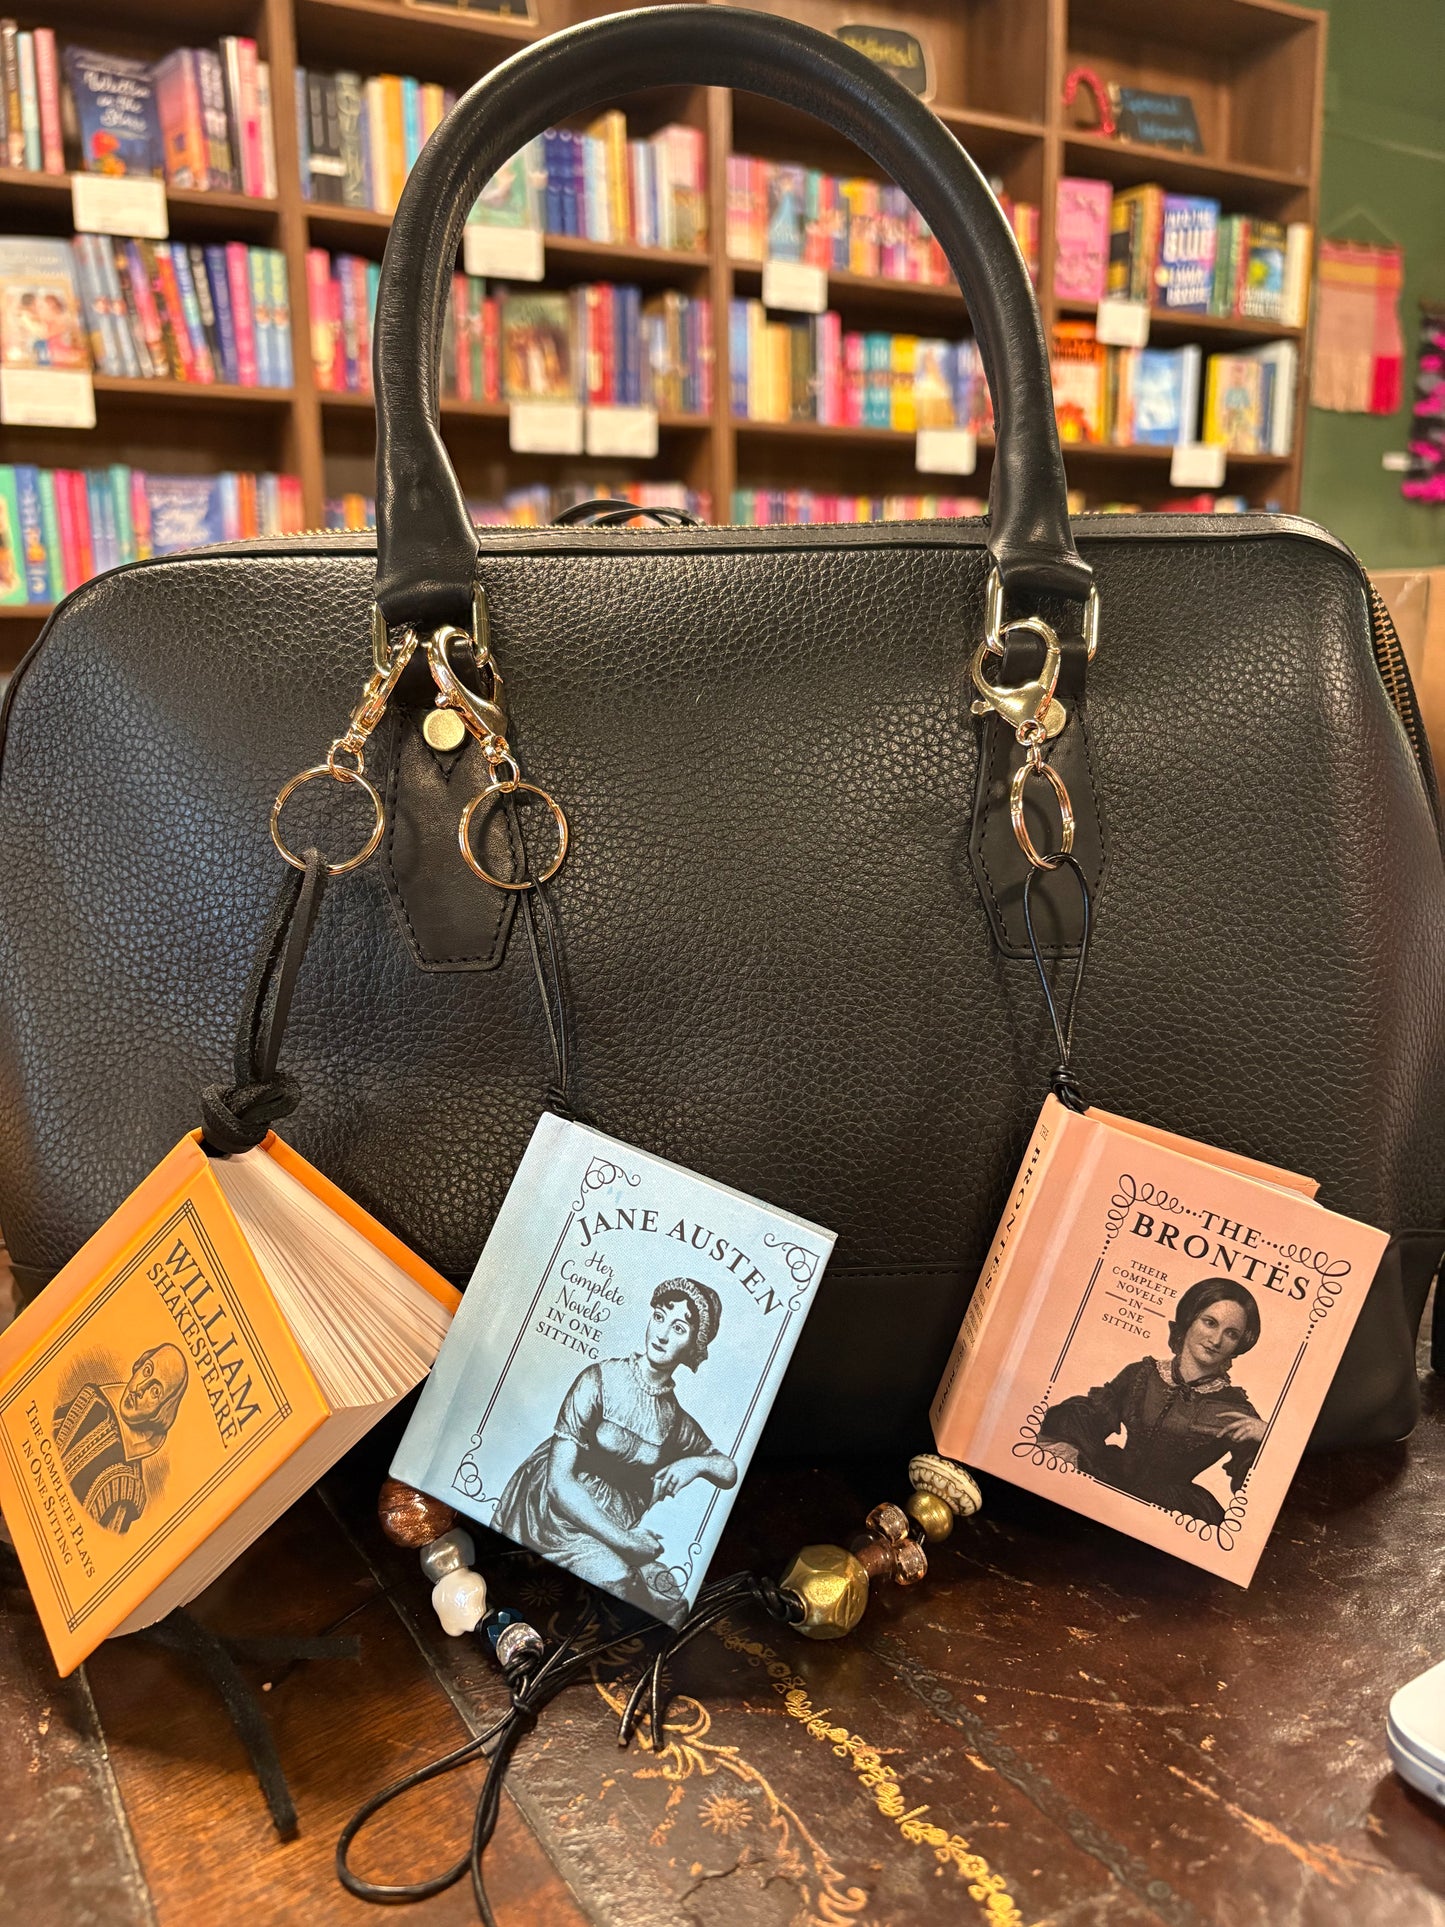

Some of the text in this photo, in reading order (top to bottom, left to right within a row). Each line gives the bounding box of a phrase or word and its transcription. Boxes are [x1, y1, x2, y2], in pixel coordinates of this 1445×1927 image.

[1163, 229, 1213, 263] BLUE
[1201, 1210, 1262, 1249] THE
[577, 1209, 783, 1316] JANE AUSTEN
[585, 1251, 615, 1278] Her
[1130, 1212, 1310, 1300] BRONTËS
[1130, 1260, 1168, 1282] THEIR
[560, 1259, 625, 1306] Complete
[1112, 1266, 1178, 1298] COMPLETE
[1116, 1281, 1164, 1306] NOVELS
[556, 1285, 611, 1323] Novels
[1118, 1307, 1145, 1324] ONE
[1128, 1298, 1144, 1310] IN
[165, 1238, 262, 1432] WILLIAM
[536, 1321, 599, 1360] SITTING
[546, 1307, 603, 1343] IN ONE
[1102, 1313, 1151, 1339] SITTING
[146, 1262, 238, 1449] SHAKESPEARE
